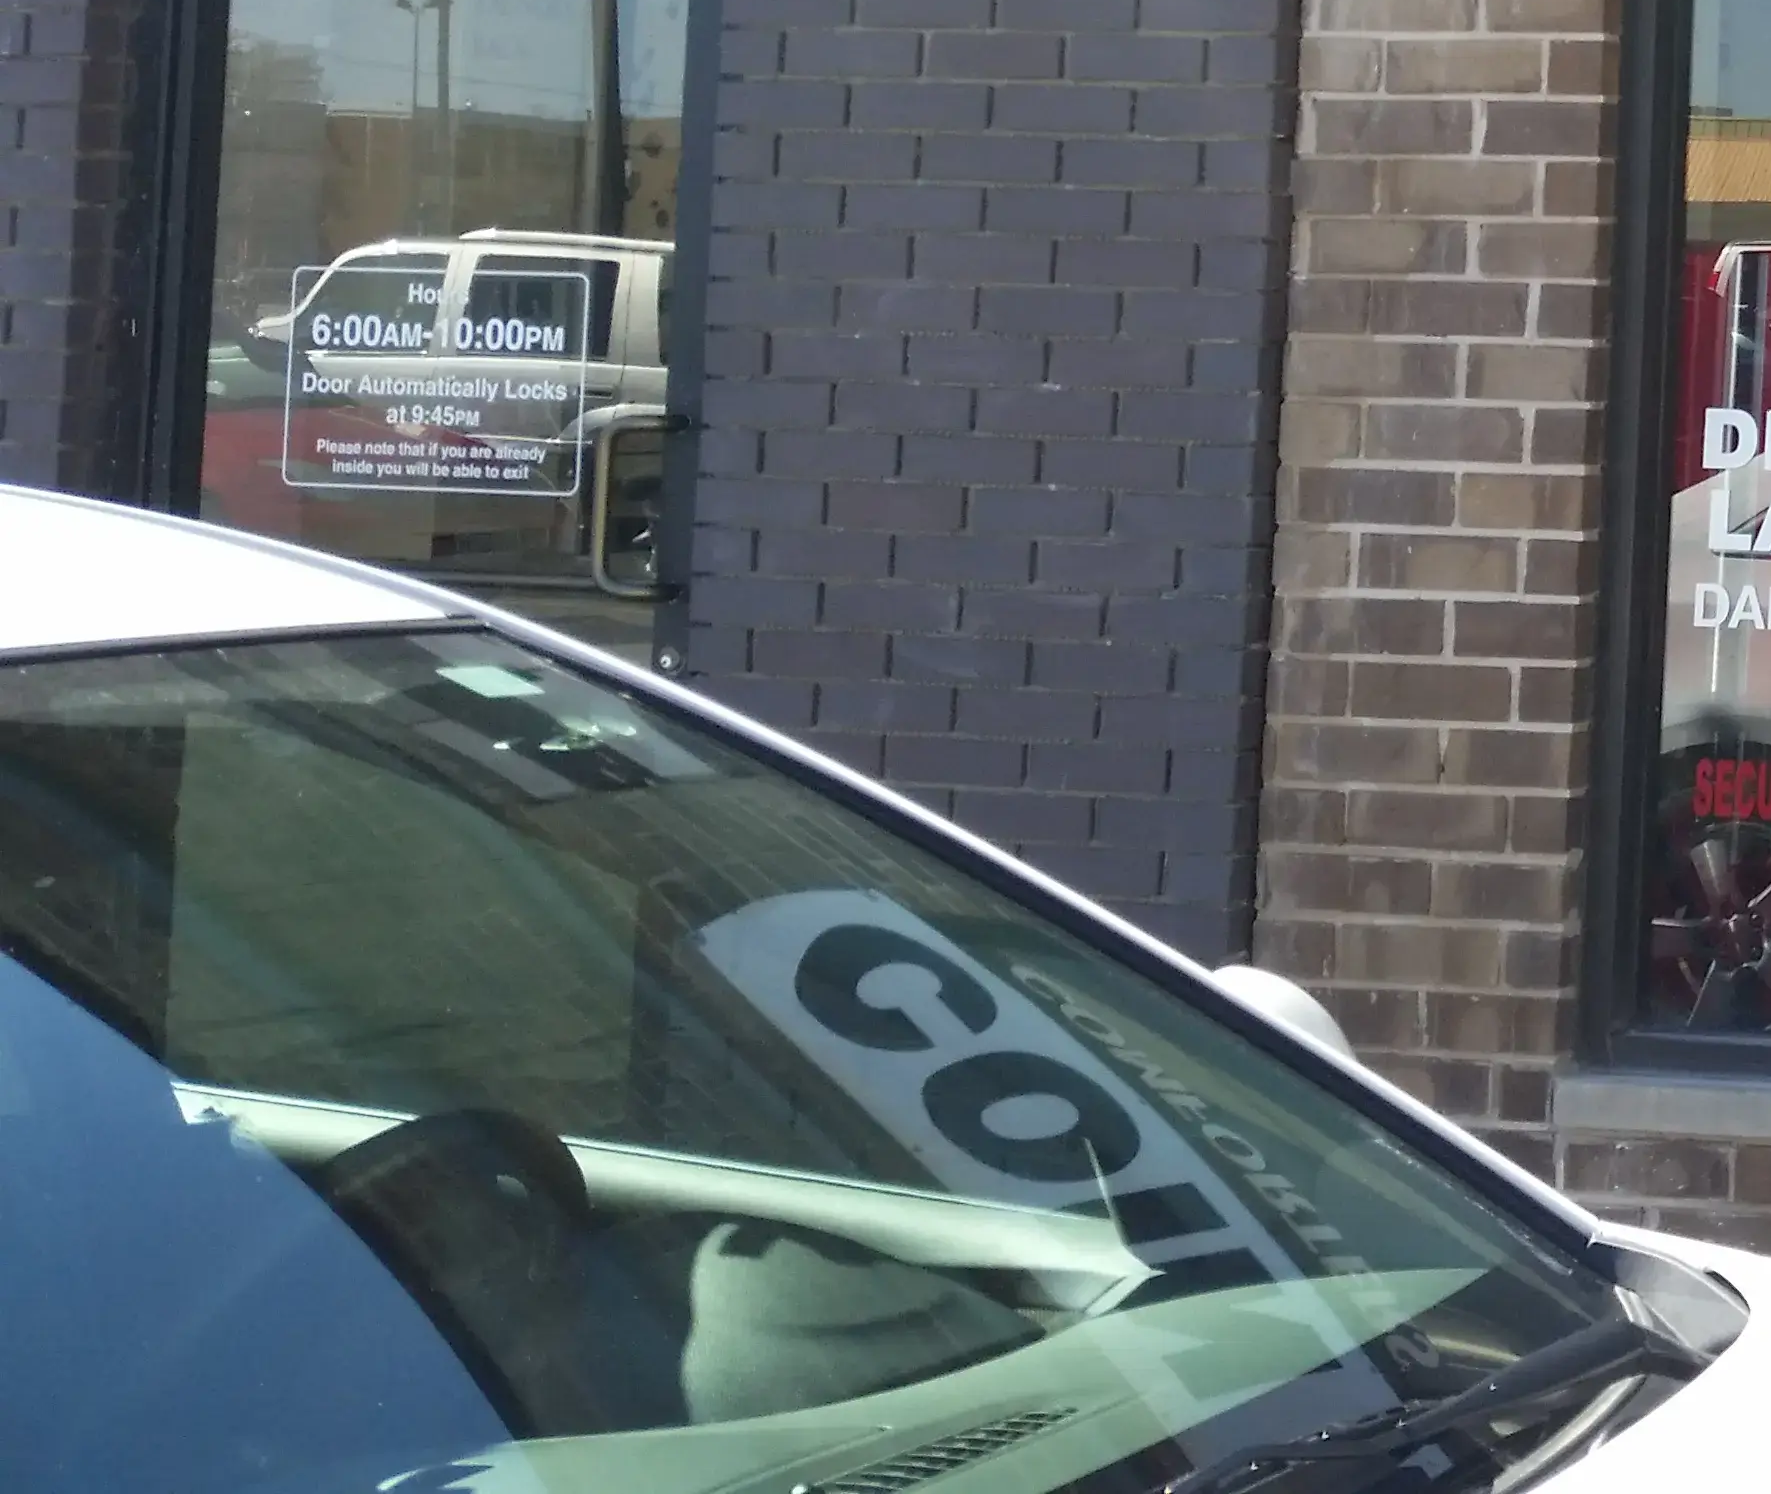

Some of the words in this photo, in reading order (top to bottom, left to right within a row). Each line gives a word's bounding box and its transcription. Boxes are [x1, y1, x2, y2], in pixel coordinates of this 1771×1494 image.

[407, 282, 470, 306] Hours
[301, 372, 353, 396] Door
[357, 373, 499, 403] Automatically
[504, 379, 568, 402] Locks
[385, 407, 406, 425] at
[409, 405, 481, 428] 9:45PM
[316, 439, 362, 457] Please
[364, 441, 395, 457] note
[398, 441, 426, 457] that
[427, 441, 439, 457] if
[440, 445, 468, 461] you
[469, 448, 493, 460] are
[495, 444, 546, 463] already
[332, 459, 374, 477] inside
[376, 463, 404, 481] you
[405, 461, 429, 477] will
[431, 462, 450, 478] be
[452, 463, 482, 479] able
[485, 464, 500, 480] to
[502, 465, 530, 481] exit
